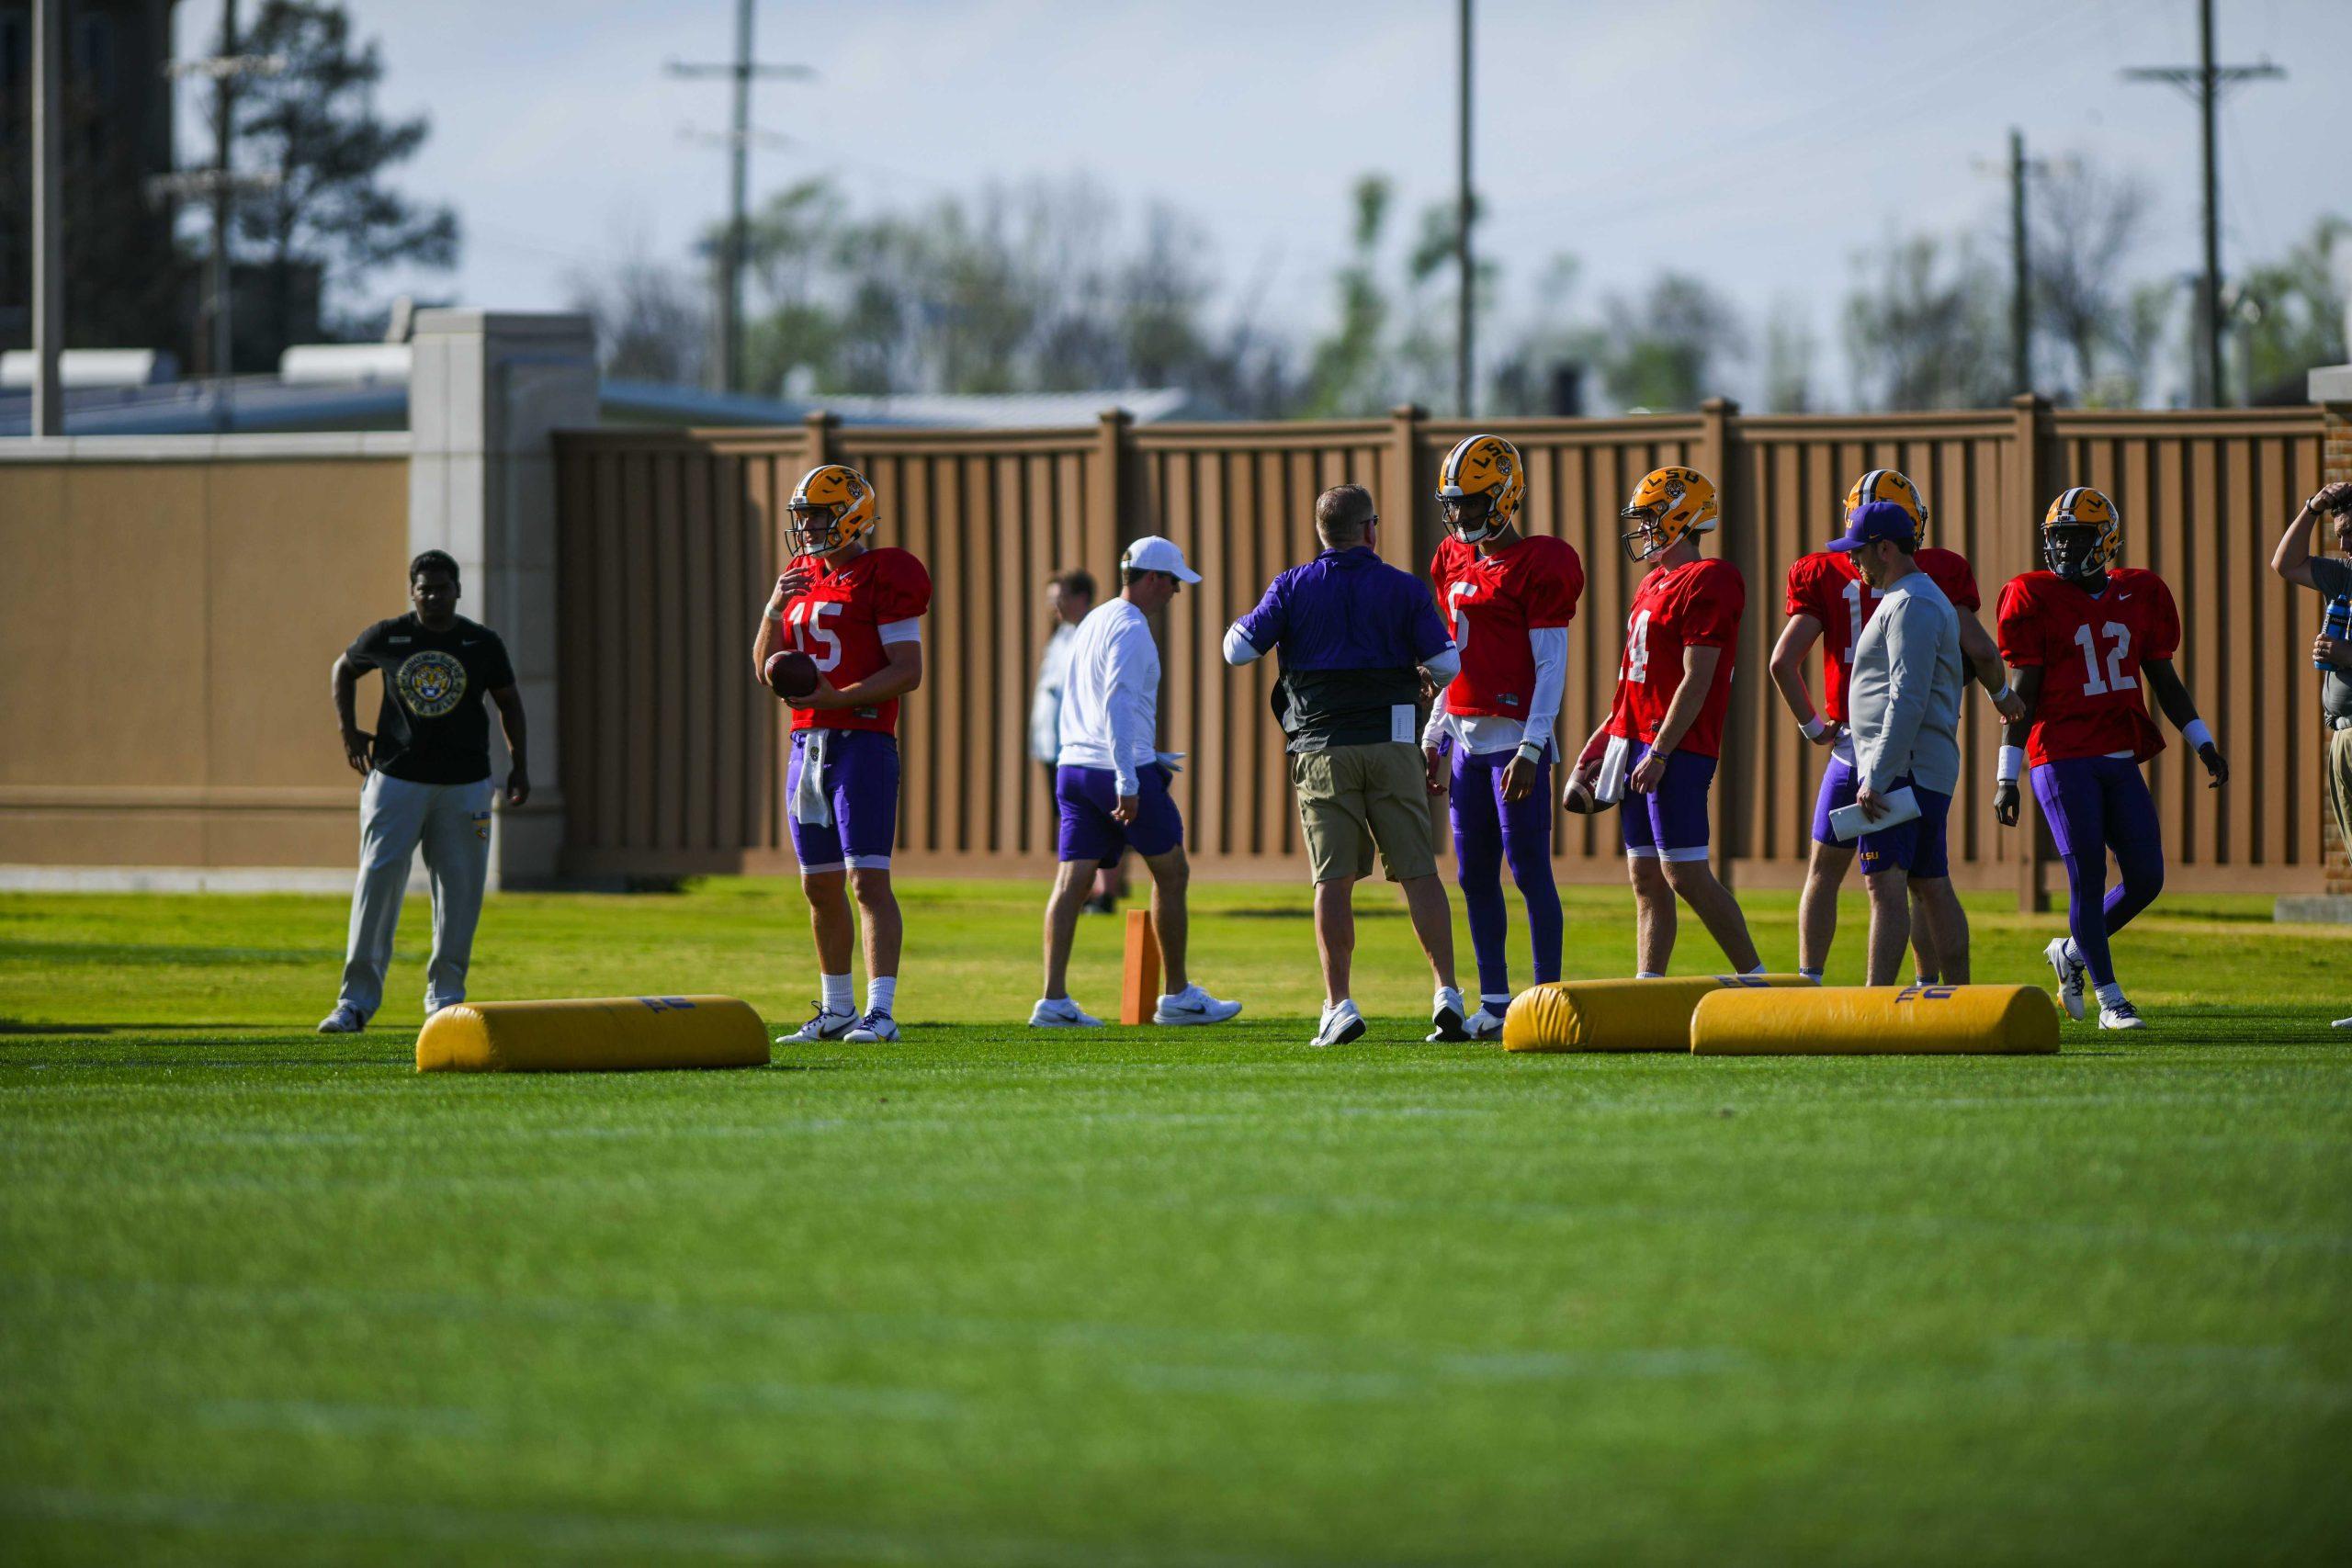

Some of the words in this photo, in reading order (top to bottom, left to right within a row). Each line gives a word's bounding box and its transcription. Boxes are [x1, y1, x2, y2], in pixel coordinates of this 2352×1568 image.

[1647, 469, 1700, 487] LSU
[787, 601, 843, 672] 15
[1447, 581, 1477, 652] 5
[1842, 578, 1885, 663] 1
[2074, 620, 2138, 696] 12
[1860, 852, 1879, 861] LSU
